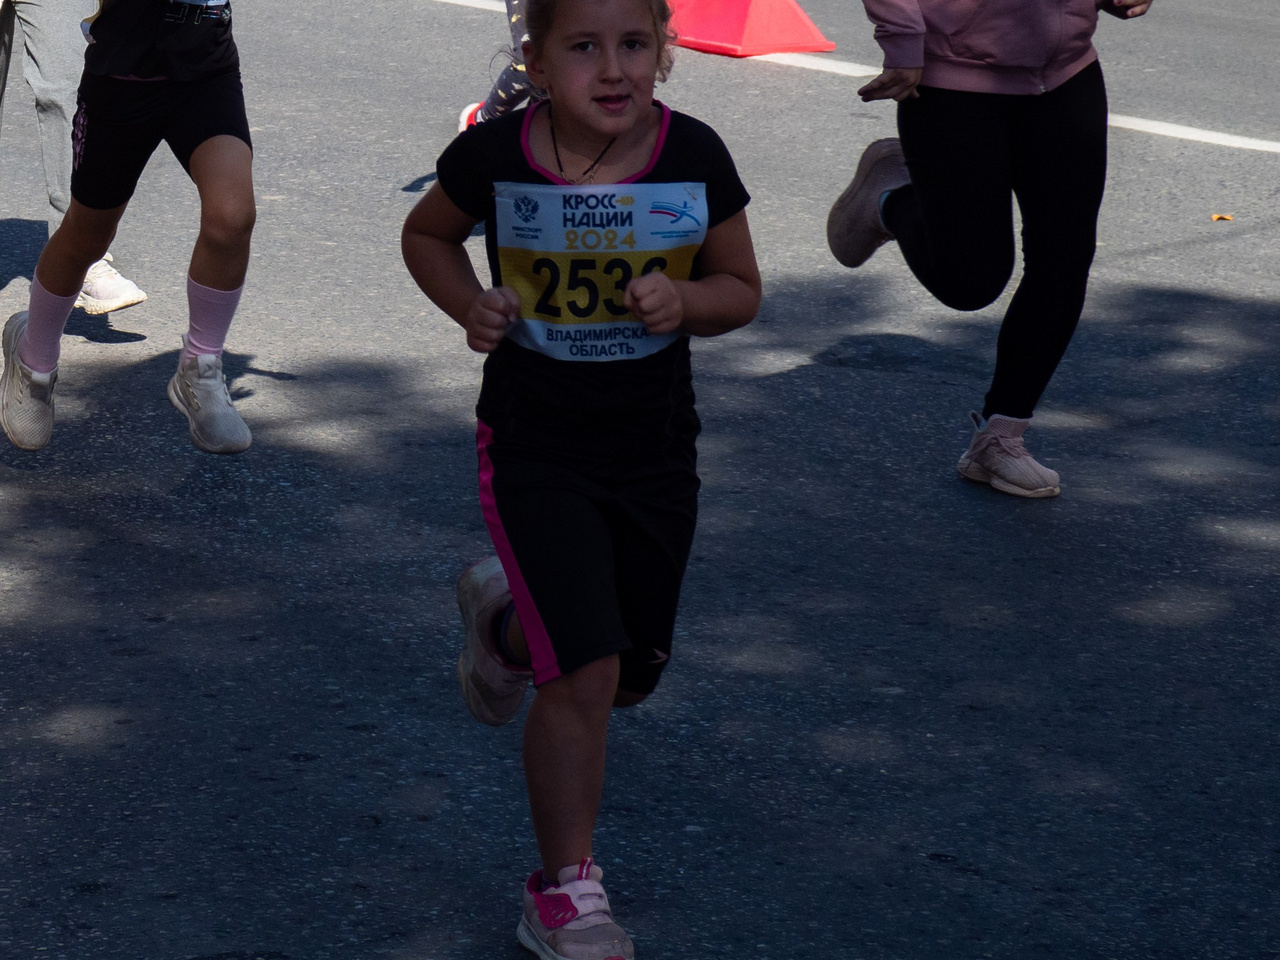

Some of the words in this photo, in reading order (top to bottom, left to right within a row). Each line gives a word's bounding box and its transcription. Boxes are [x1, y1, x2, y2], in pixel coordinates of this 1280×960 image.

[562, 194, 616, 210] КРОСС
[562, 211, 634, 229] НАЦИИ
[564, 229, 637, 250] 2024
[546, 327, 649, 343] ВЛАДИМИРСКА
[568, 342, 636, 357] ОБЛАСТЬ
